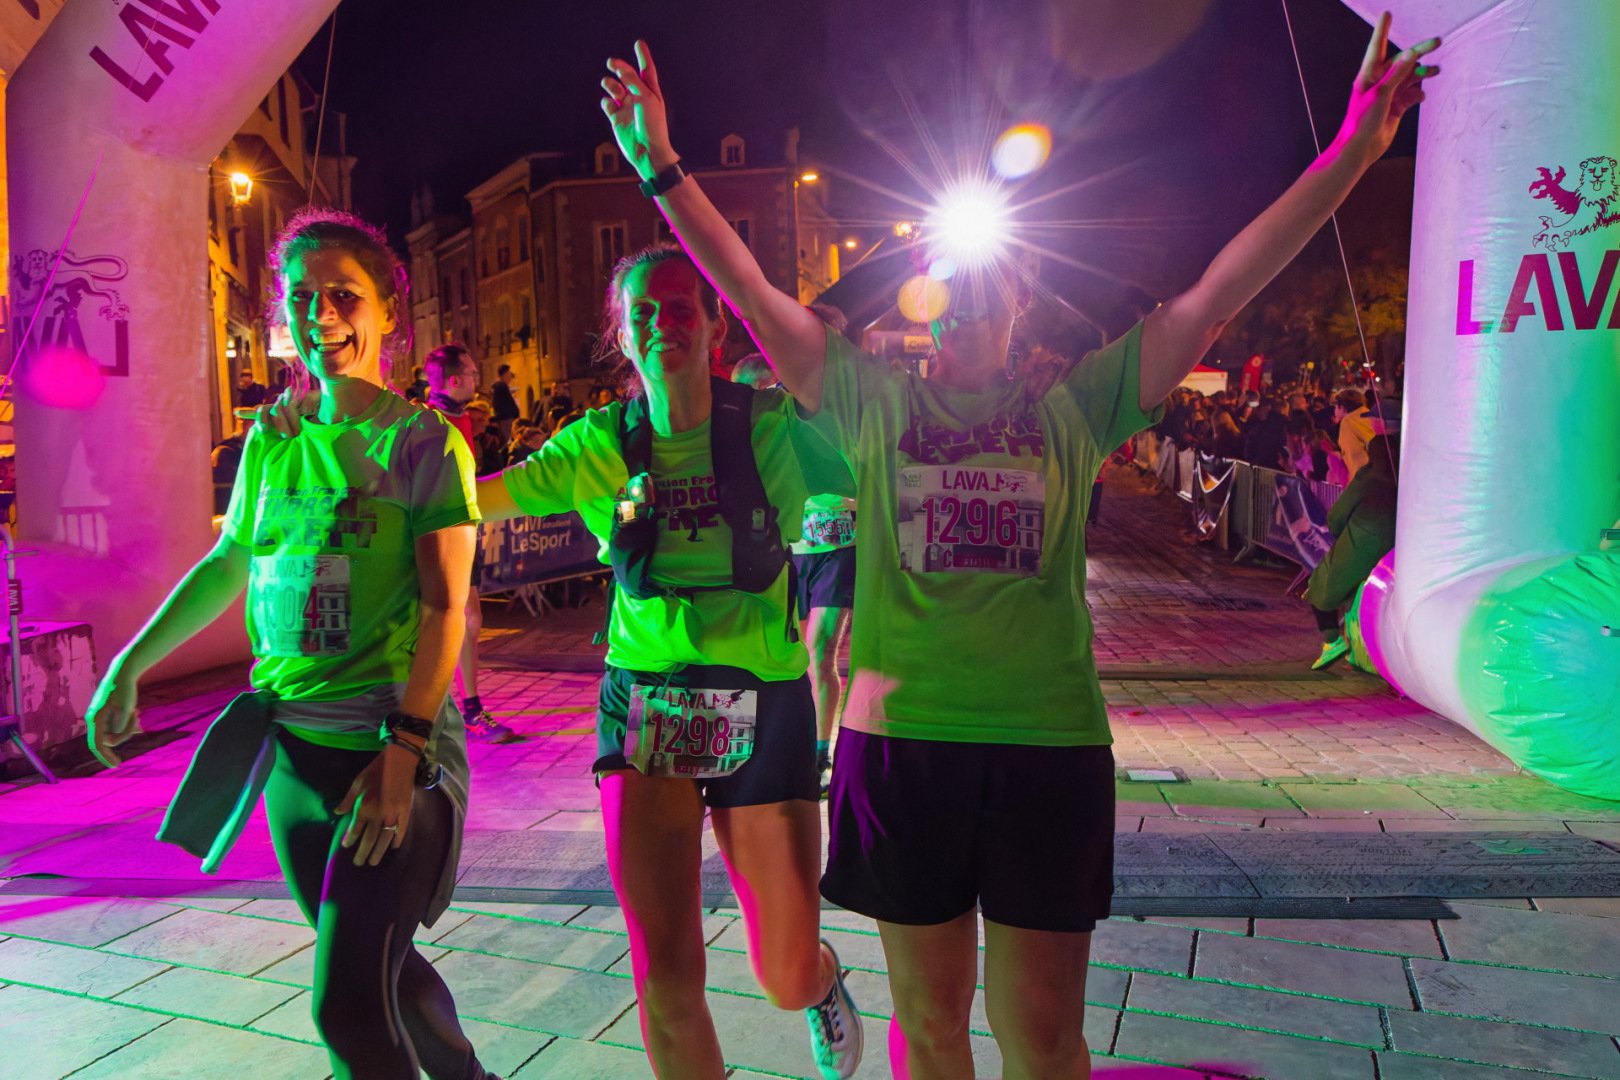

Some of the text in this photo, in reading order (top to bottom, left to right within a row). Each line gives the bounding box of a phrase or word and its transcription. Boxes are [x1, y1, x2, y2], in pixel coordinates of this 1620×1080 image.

[89, 0, 221, 103] LAV
[1456, 250, 1620, 336] LAV
[942, 470, 1002, 492] LAVAL
[510, 530, 571, 555] LeSport
[921, 497, 1018, 548] 1296
[668, 690, 716, 710] LAVAL
[652, 714, 730, 757] 1298
